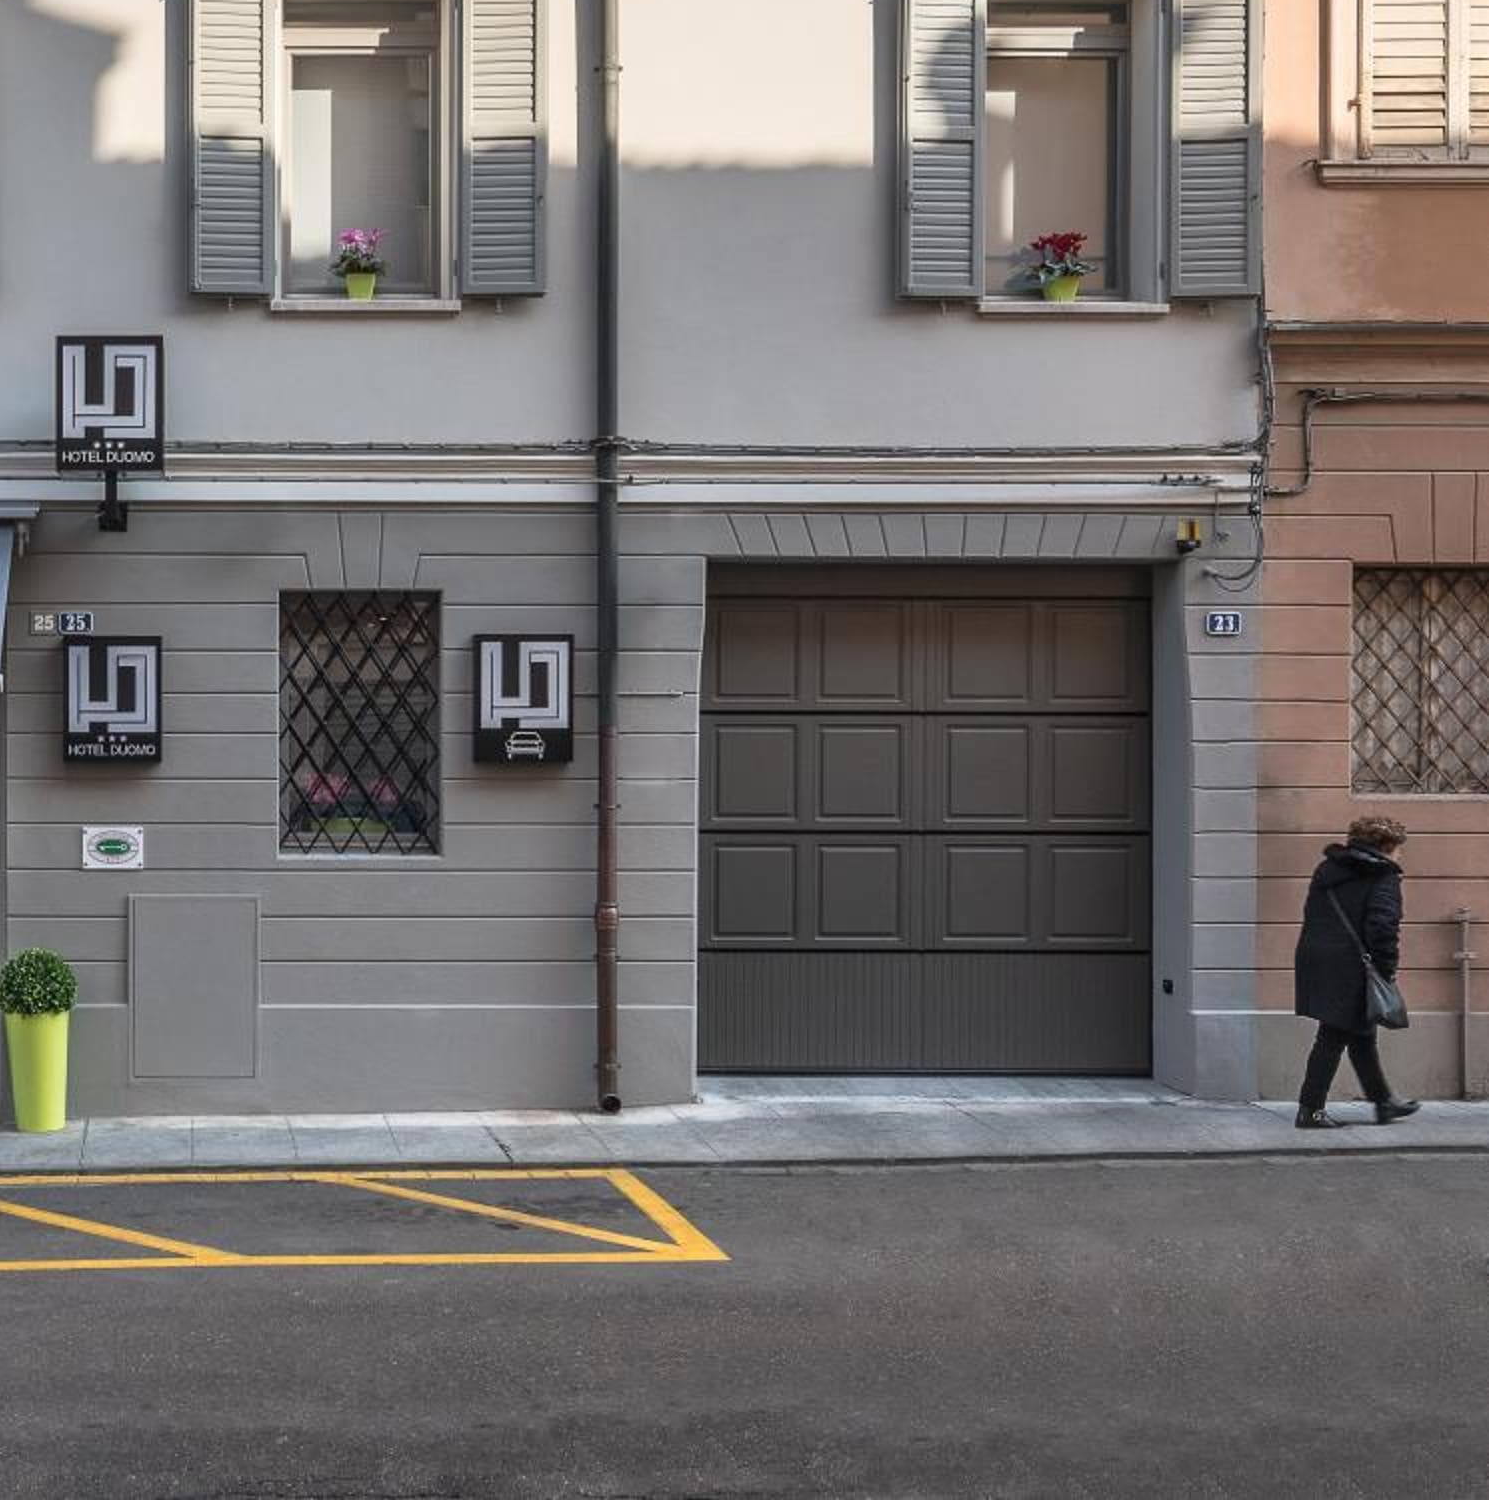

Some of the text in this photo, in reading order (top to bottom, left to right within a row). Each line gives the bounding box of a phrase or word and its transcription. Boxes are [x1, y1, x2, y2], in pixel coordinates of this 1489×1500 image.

[62, 451, 156, 463] HOTEL DUOMO
[34, 614, 55, 631] 25
[65, 614, 87, 631] 25
[1214, 615, 1235, 631] 23
[68, 743, 156, 756] HOTEL DUOMO
